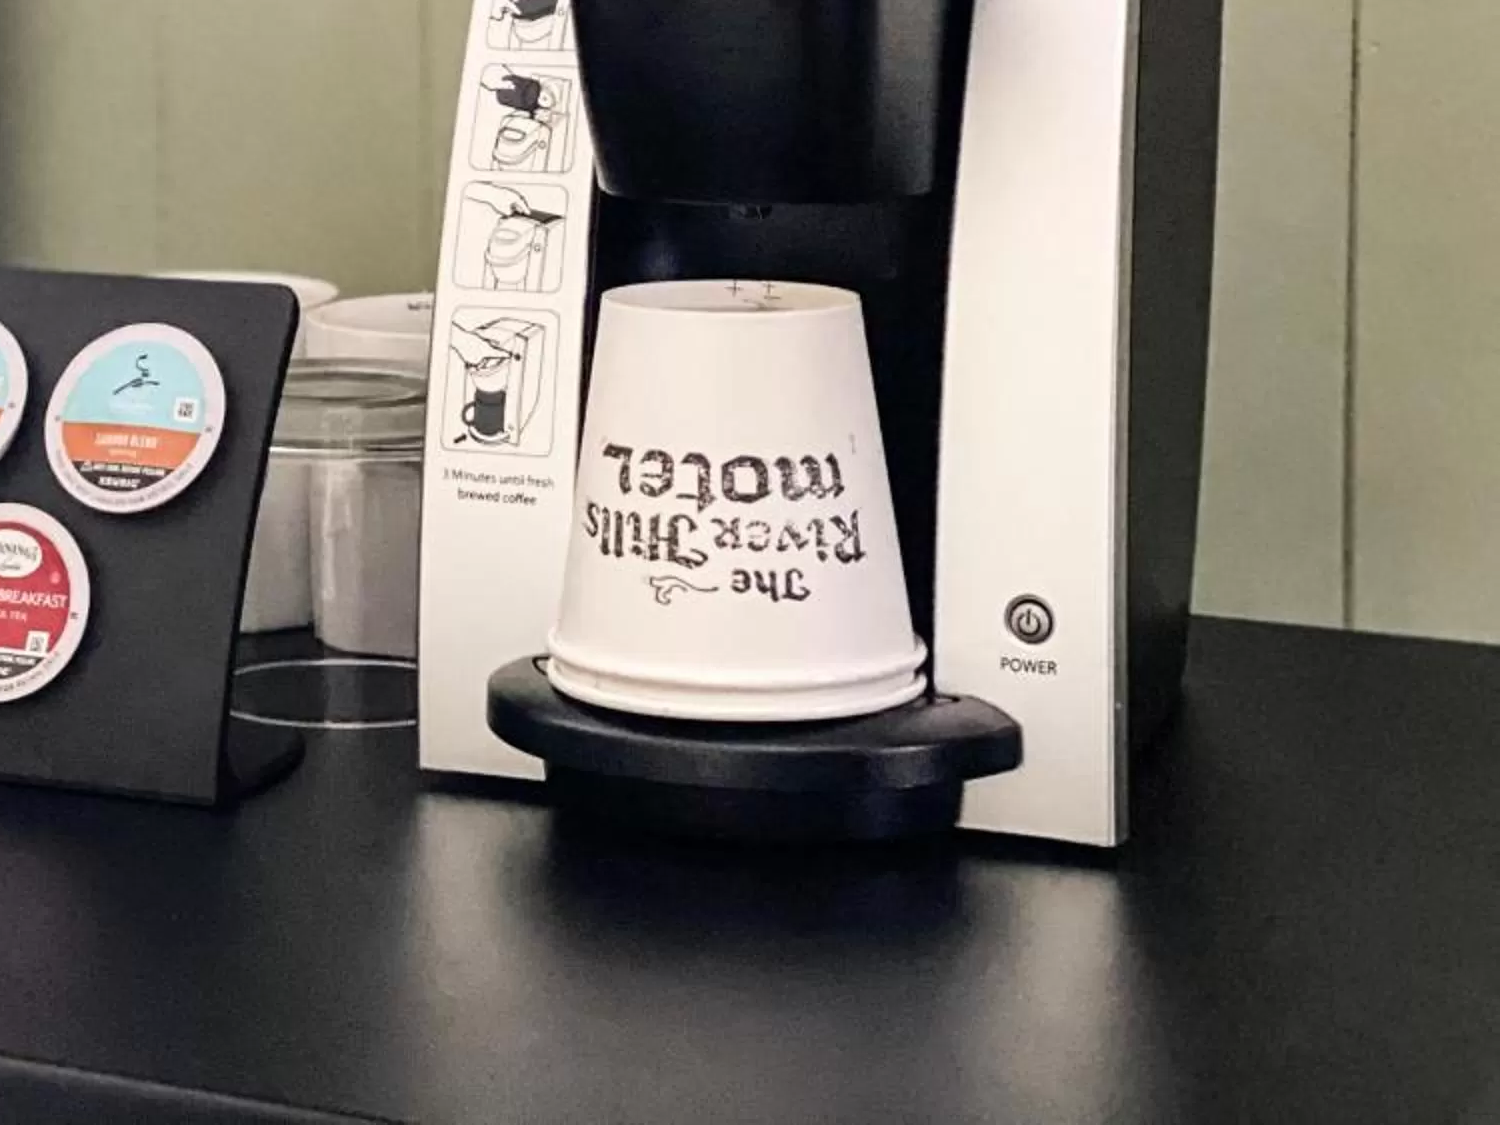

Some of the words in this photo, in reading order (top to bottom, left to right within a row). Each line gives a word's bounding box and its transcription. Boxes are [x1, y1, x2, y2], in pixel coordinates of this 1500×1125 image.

[451, 469, 497, 484] Minutes
[457, 486, 500, 503] brewed
[502, 492, 537, 505] coffee
[584, 501, 708, 568] Hills
[730, 568, 811, 602] The
[1000, 656, 1057, 675] POWER
